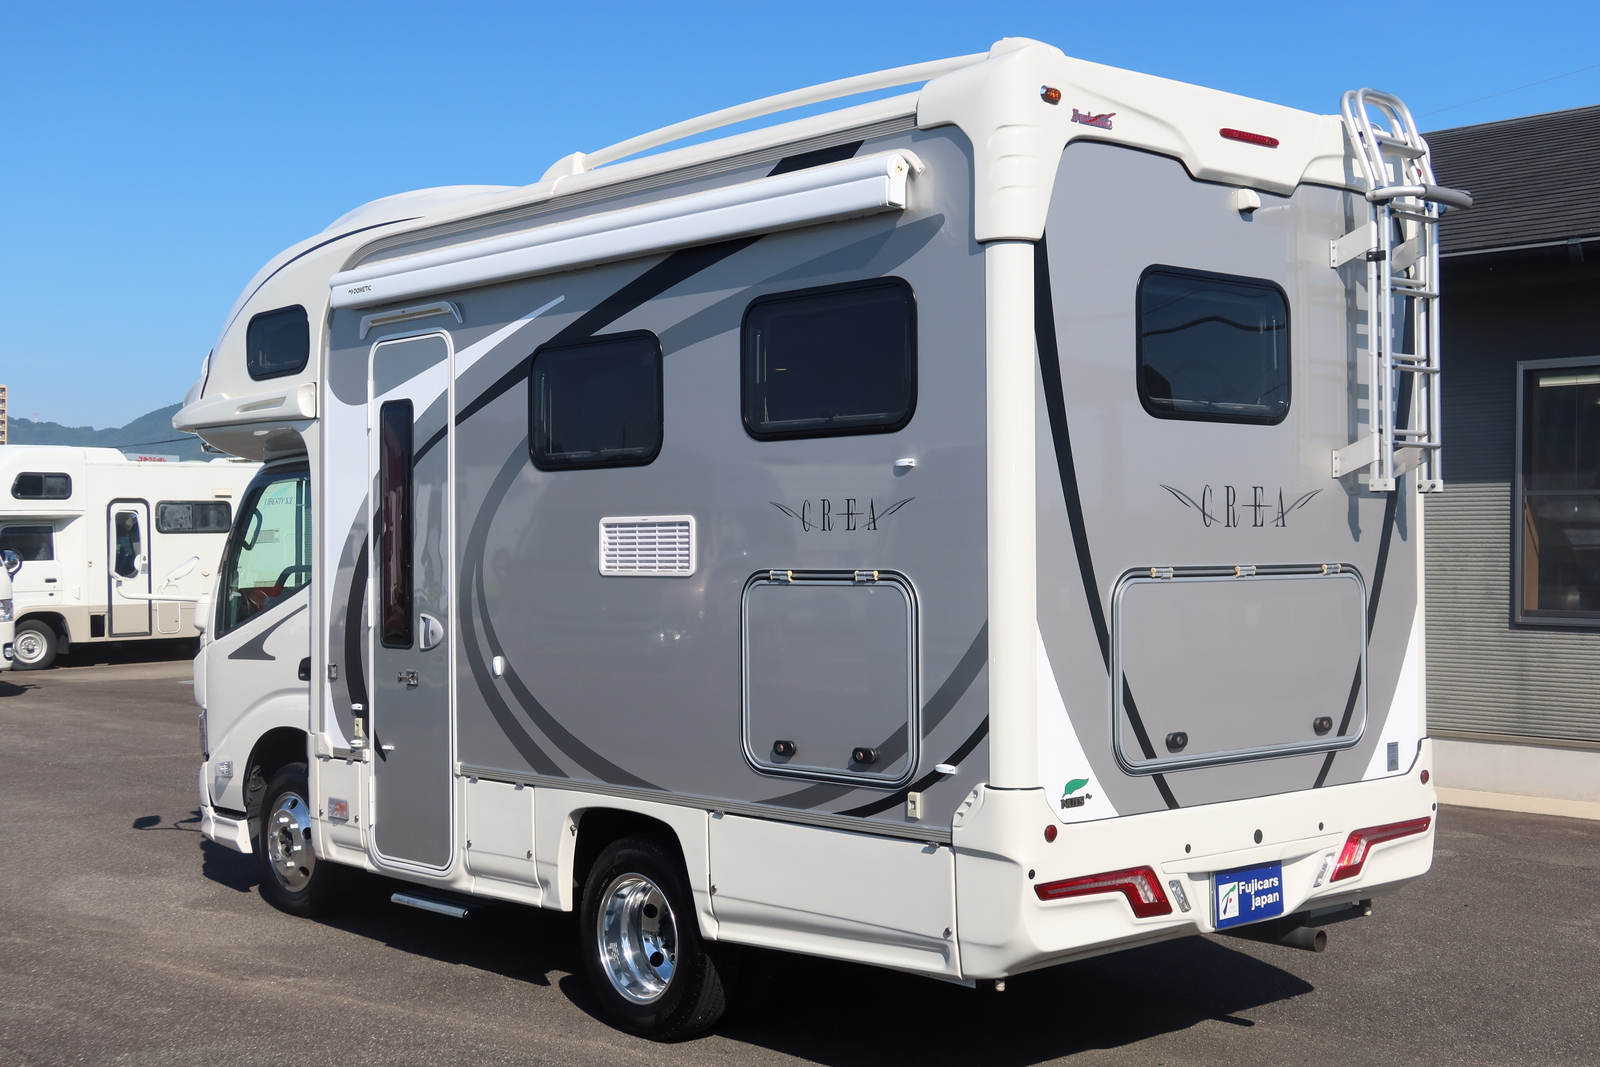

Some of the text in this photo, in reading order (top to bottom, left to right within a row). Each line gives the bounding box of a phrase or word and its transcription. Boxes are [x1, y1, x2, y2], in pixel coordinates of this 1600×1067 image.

[353, 284, 372, 295] DOMETIC
[264, 496, 285, 506] LIBERTY
[1202, 484, 1287, 528] CREA
[802, 497, 878, 532] CREA
[1060, 795, 1086, 810] NUTS
[1238, 876, 1280, 895] Fujicars
[1251, 892, 1280, 911] japan
